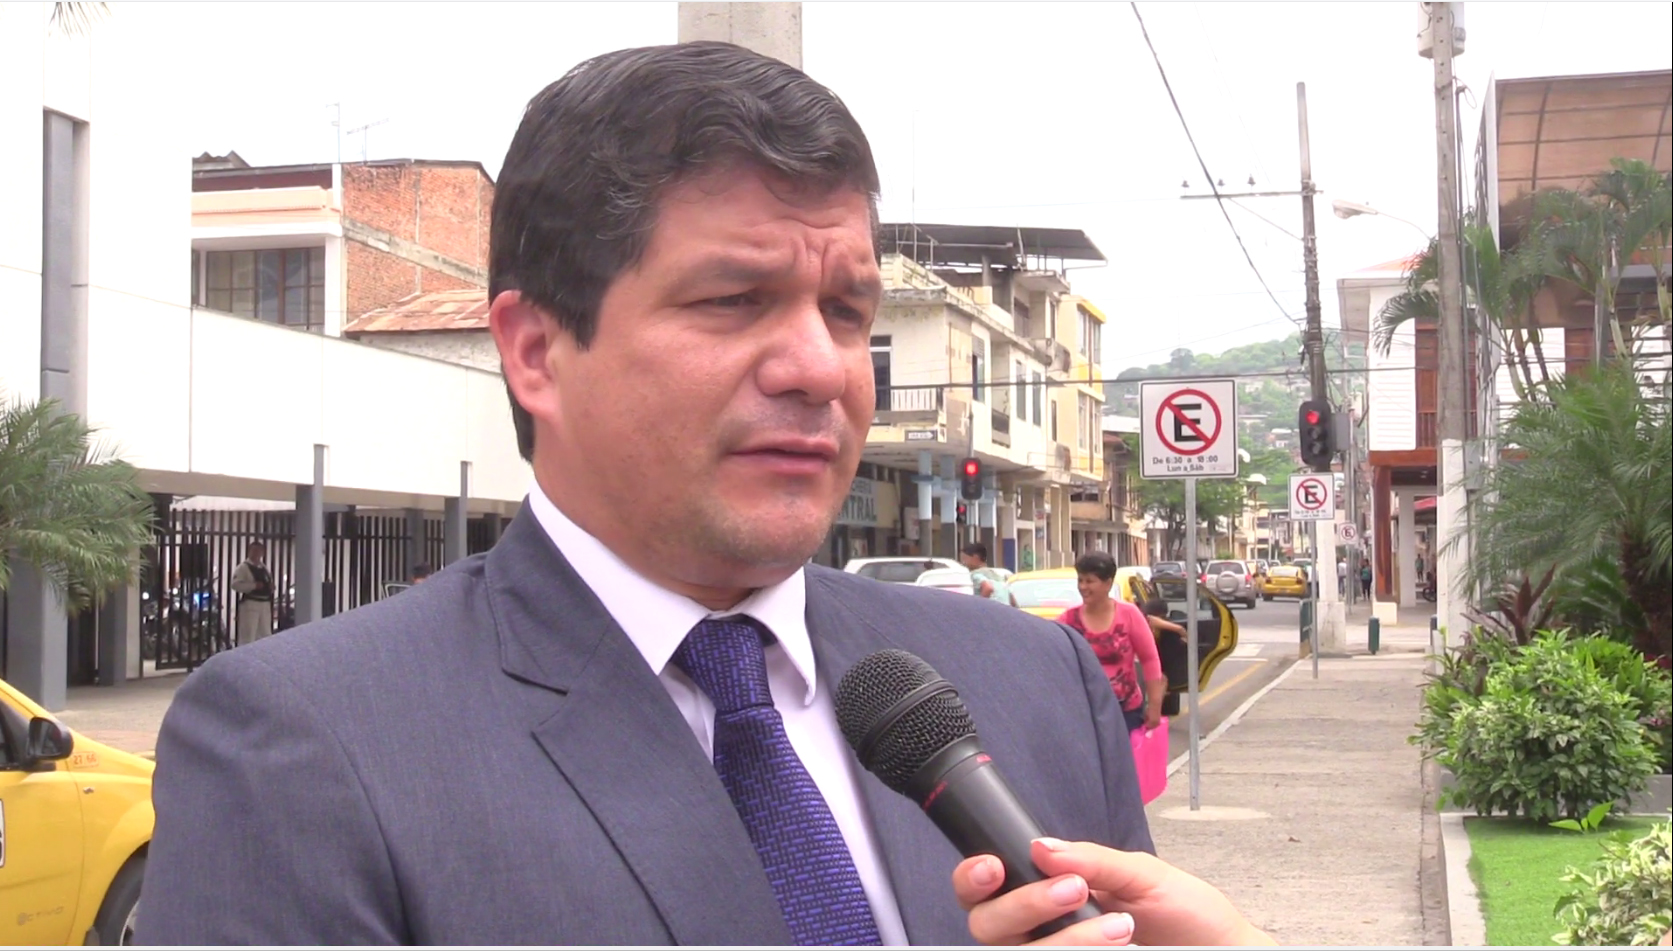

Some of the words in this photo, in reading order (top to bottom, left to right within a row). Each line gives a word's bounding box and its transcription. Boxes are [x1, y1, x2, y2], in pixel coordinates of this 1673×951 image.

[1173, 403, 1203, 443] E
[1152, 456, 1164, 465] De
[1165, 456, 1183, 464] 6:30
[1304, 485, 1318, 504] E
[838, 494, 878, 522] NTRAL
